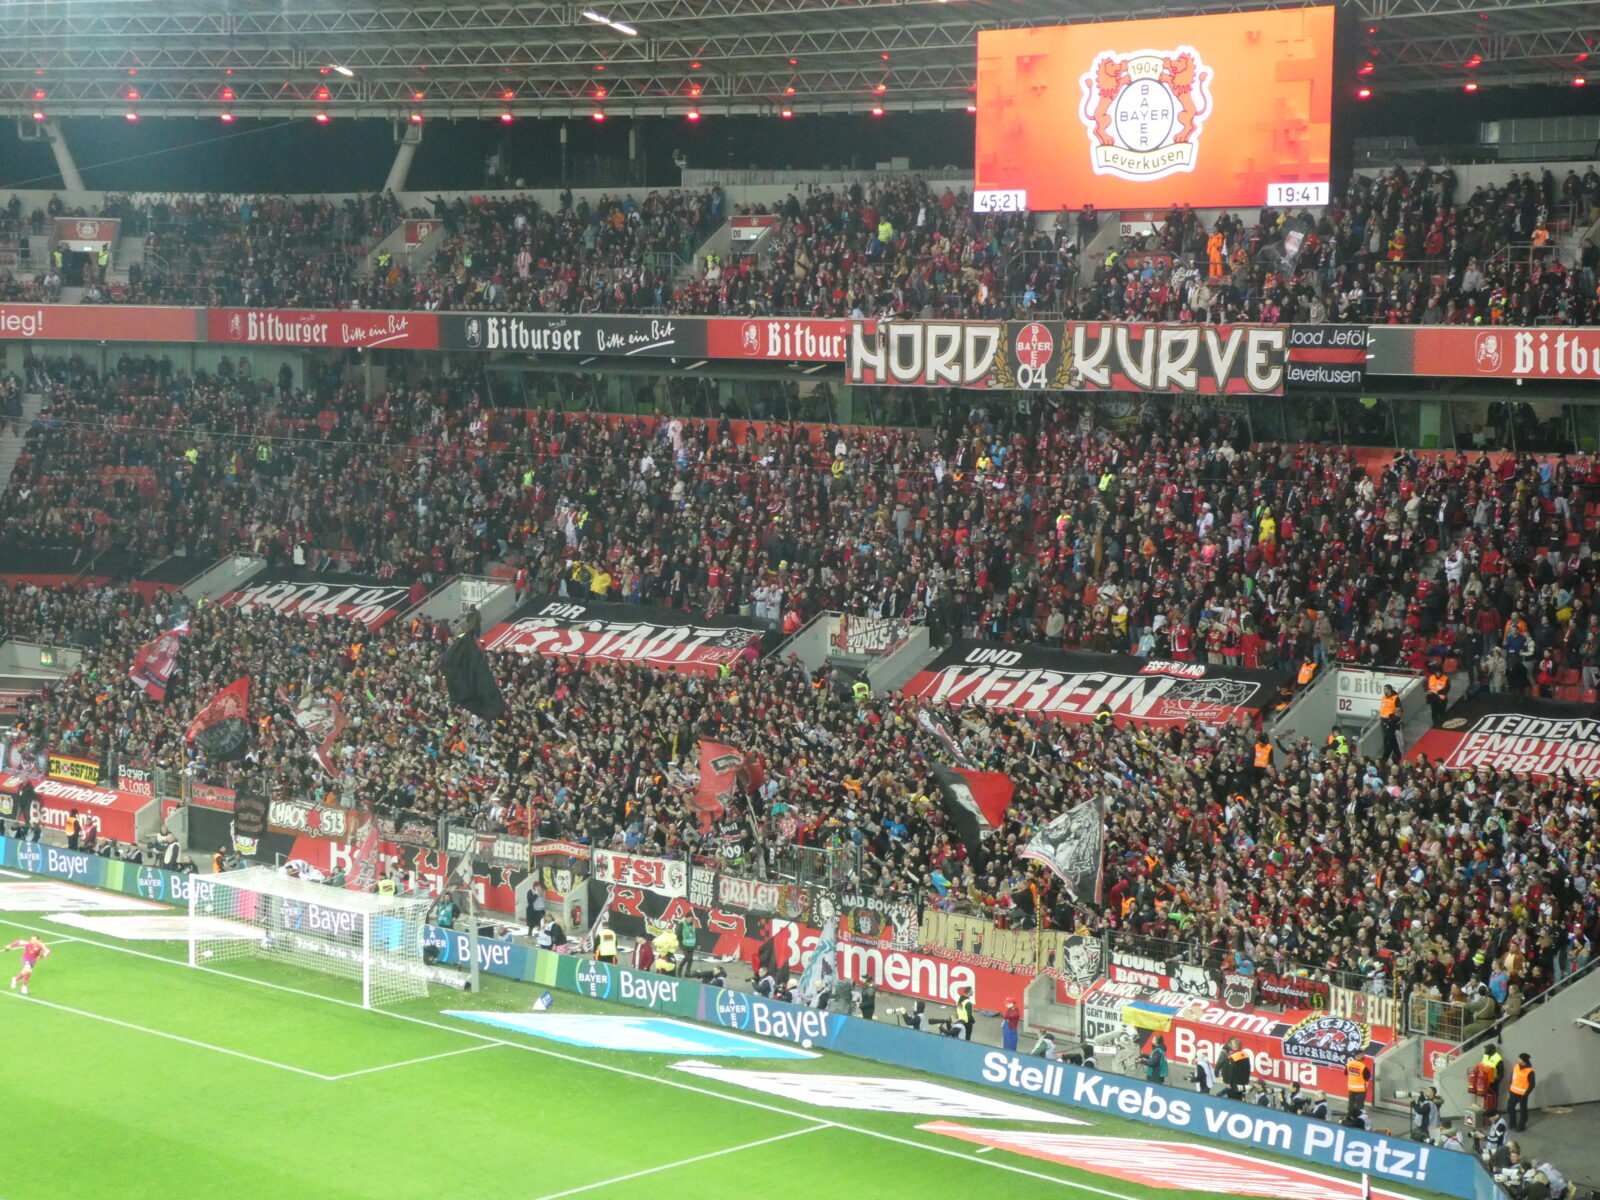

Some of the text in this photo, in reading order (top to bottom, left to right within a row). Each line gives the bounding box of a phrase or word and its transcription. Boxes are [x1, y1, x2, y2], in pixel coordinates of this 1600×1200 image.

[1131, 62, 1159, 75] 1904
[1120, 109, 1169, 122] BAYER
[1140, 84, 1149, 147] BAYER
[1104, 150, 1184, 170] Leverkusen
[980, 194, 1020, 210] 45:21
[1277, 187, 1320, 203] 19:41
[247, 311, 328, 343] Bitburger
[342, 315, 408, 344] Bitte ein Bit
[486, 317, 581, 351] Bitburger
[597, 320, 675, 351] Bitte ein Bit
[1290, 329, 1324, 344] Jood
[766, 322, 847, 358] Bitbur
[1017, 341, 1051, 351] BAYER
[1031, 325, 1039, 368] BAYER
[1073, 325, 1284, 392] KURVE
[1017, 363, 1048, 389] 04
[1287, 365, 1361, 383] Leverkusen
[539, 602, 586, 619] FÜR
[551, 620, 727, 662] STADT
[965, 648, 1023, 666] UND
[930, 666, 1176, 716] VEREIN
[1339, 698, 1352, 711] D2
[34, 780, 118, 806] Barmenia
[19, 852, 40, 861] BAYER
[48, 849, 89, 879] Bayer
[139, 878, 162, 887] BAYER
[611, 856, 665, 890] FSI
[692, 867, 715, 881] WEST
[691, 880, 714, 896] SIDE
[689, 892, 713, 908] BOYZ
[841, 894, 865, 908] MAD
[308, 903, 358, 935] Bayer
[457, 935, 511, 971] Byer
[1113, 951, 1167, 976] YOUNG
[578, 972, 608, 984] BAYER
[1115, 967, 1160, 988] BOYS
[620, 970, 679, 1008] Bayer
[1261, 981, 1310, 998] Leverkusen
[720, 1004, 747, 1014] BAYER
[1104, 1010, 1118, 1021] MIR
[752, 1003, 829, 1043] Bayer
[1175, 1026, 1318, 1086] Barenia
[1284, 1043, 1347, 1063] LEVERKUSE
[981, 1051, 1430, 1181] Stell Krebs vom Platz!
